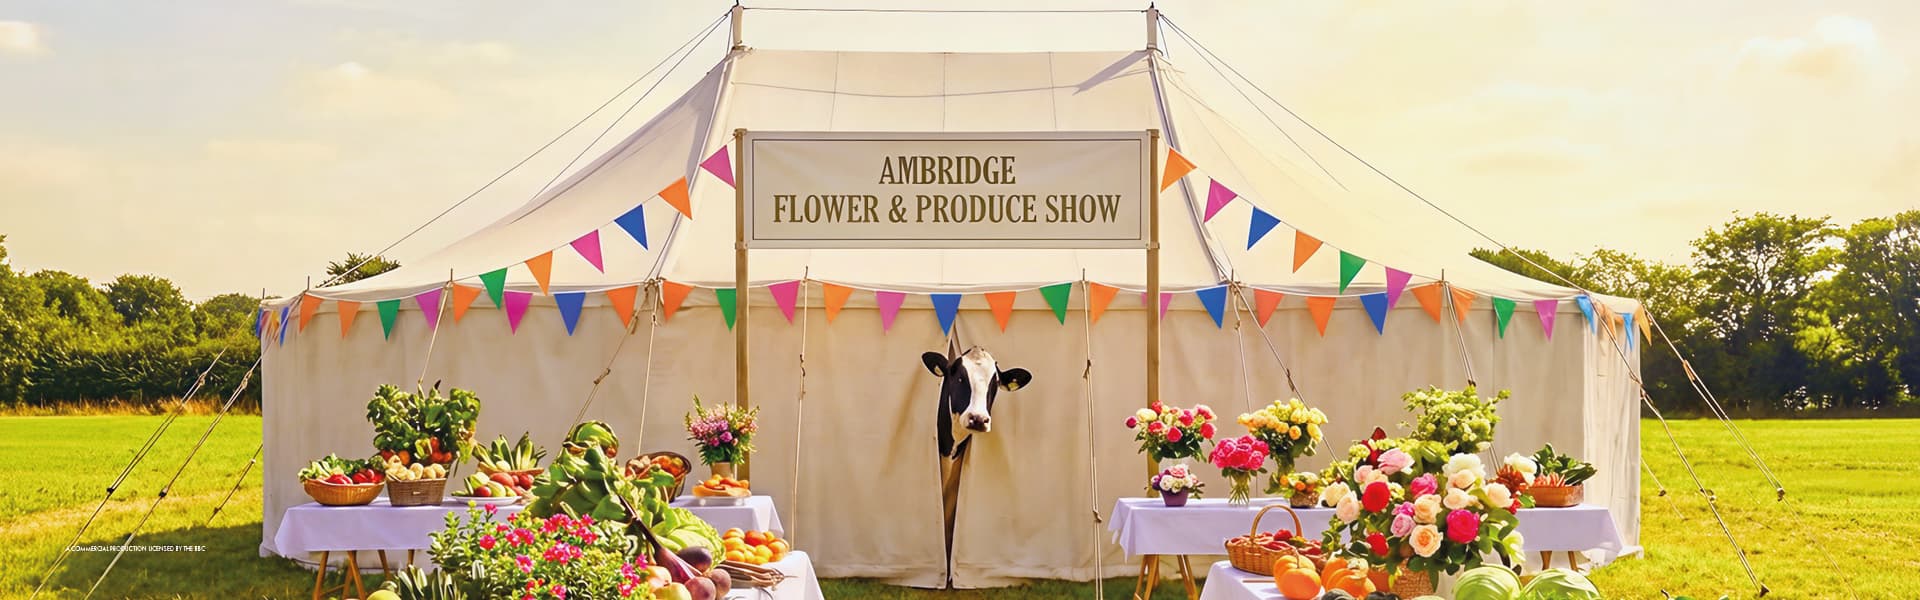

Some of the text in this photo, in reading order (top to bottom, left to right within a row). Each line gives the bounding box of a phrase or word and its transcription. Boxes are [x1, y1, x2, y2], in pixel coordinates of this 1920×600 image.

[878, 155, 1017, 185] AMBRIDGE
[773, 194, 1122, 224] FLOWER & PRODUCE SHOW
